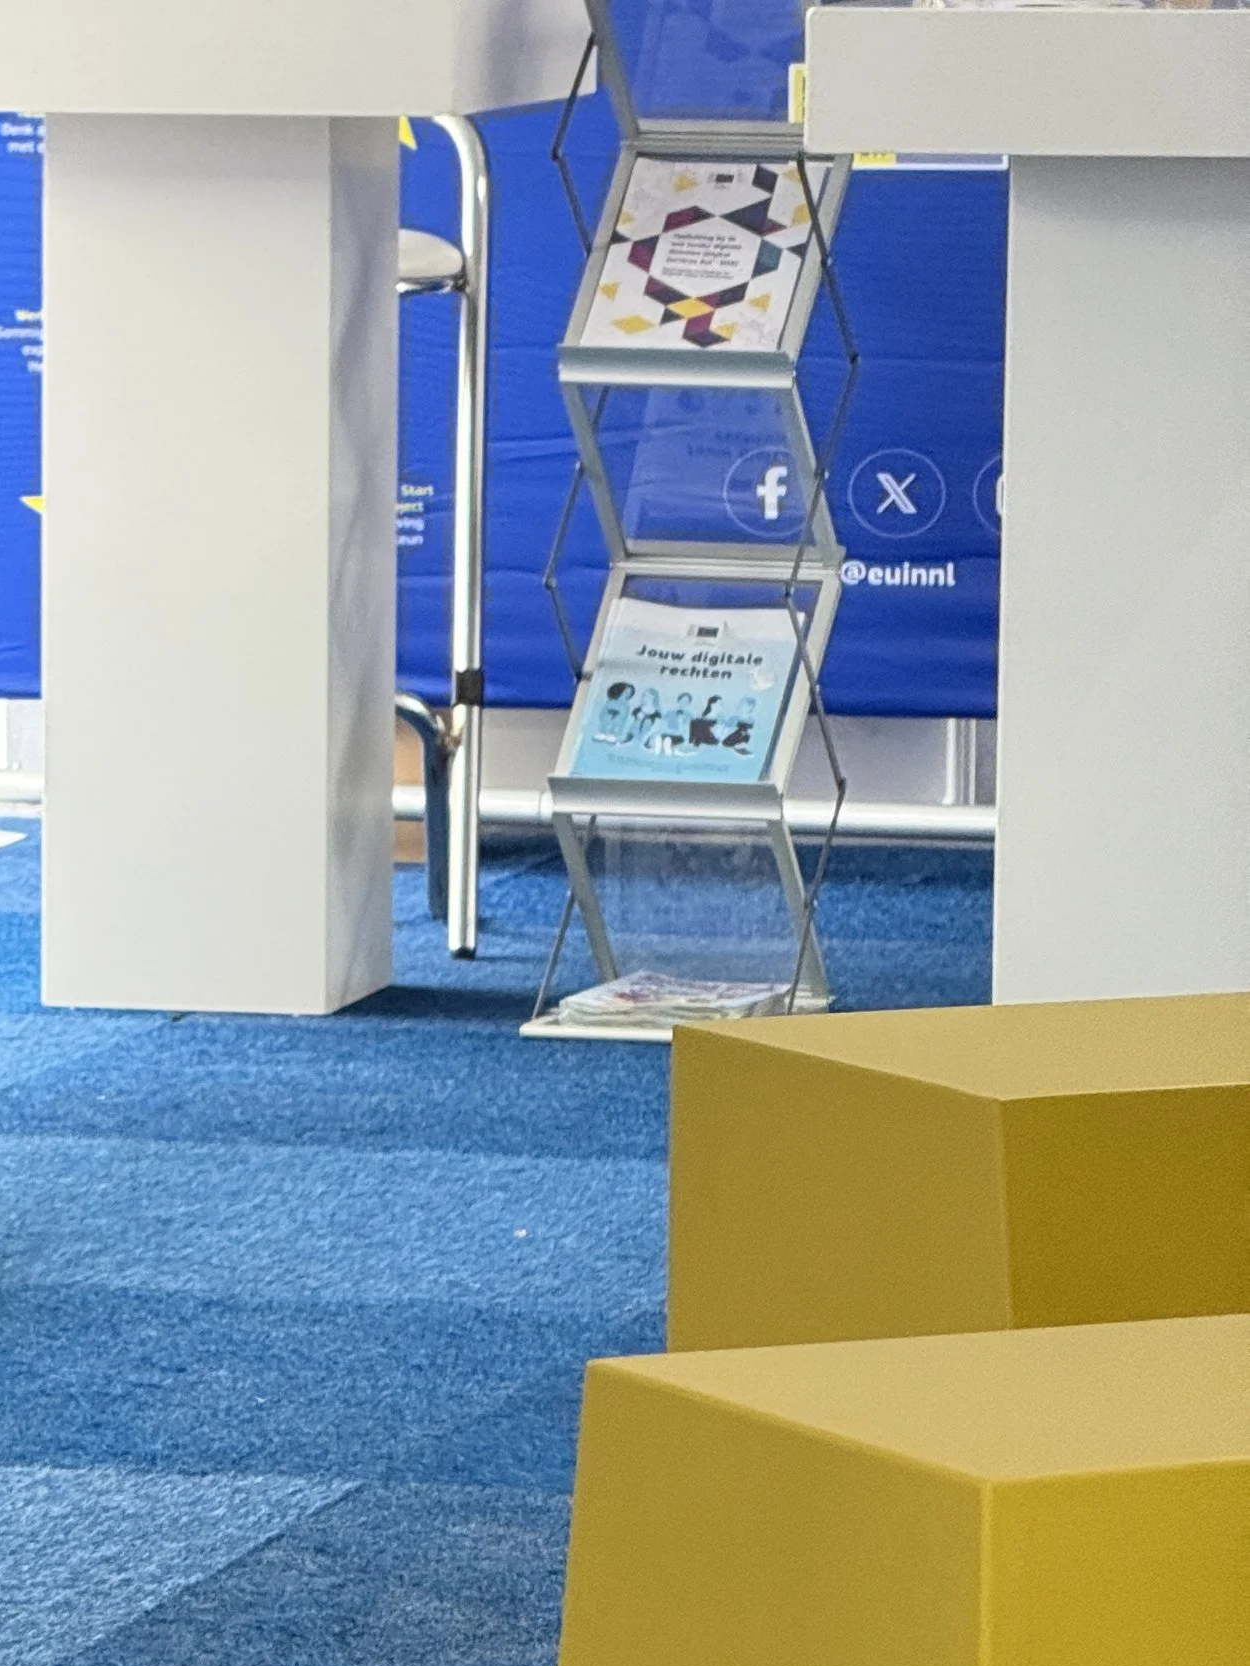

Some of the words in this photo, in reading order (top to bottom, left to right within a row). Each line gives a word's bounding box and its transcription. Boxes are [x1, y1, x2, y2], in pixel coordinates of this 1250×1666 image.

[841, 561, 955, 587] @euinnl
[636, 644, 685, 661] Jouw
[691, 651, 763, 667] digitale
[660, 665, 732, 680] rechten
